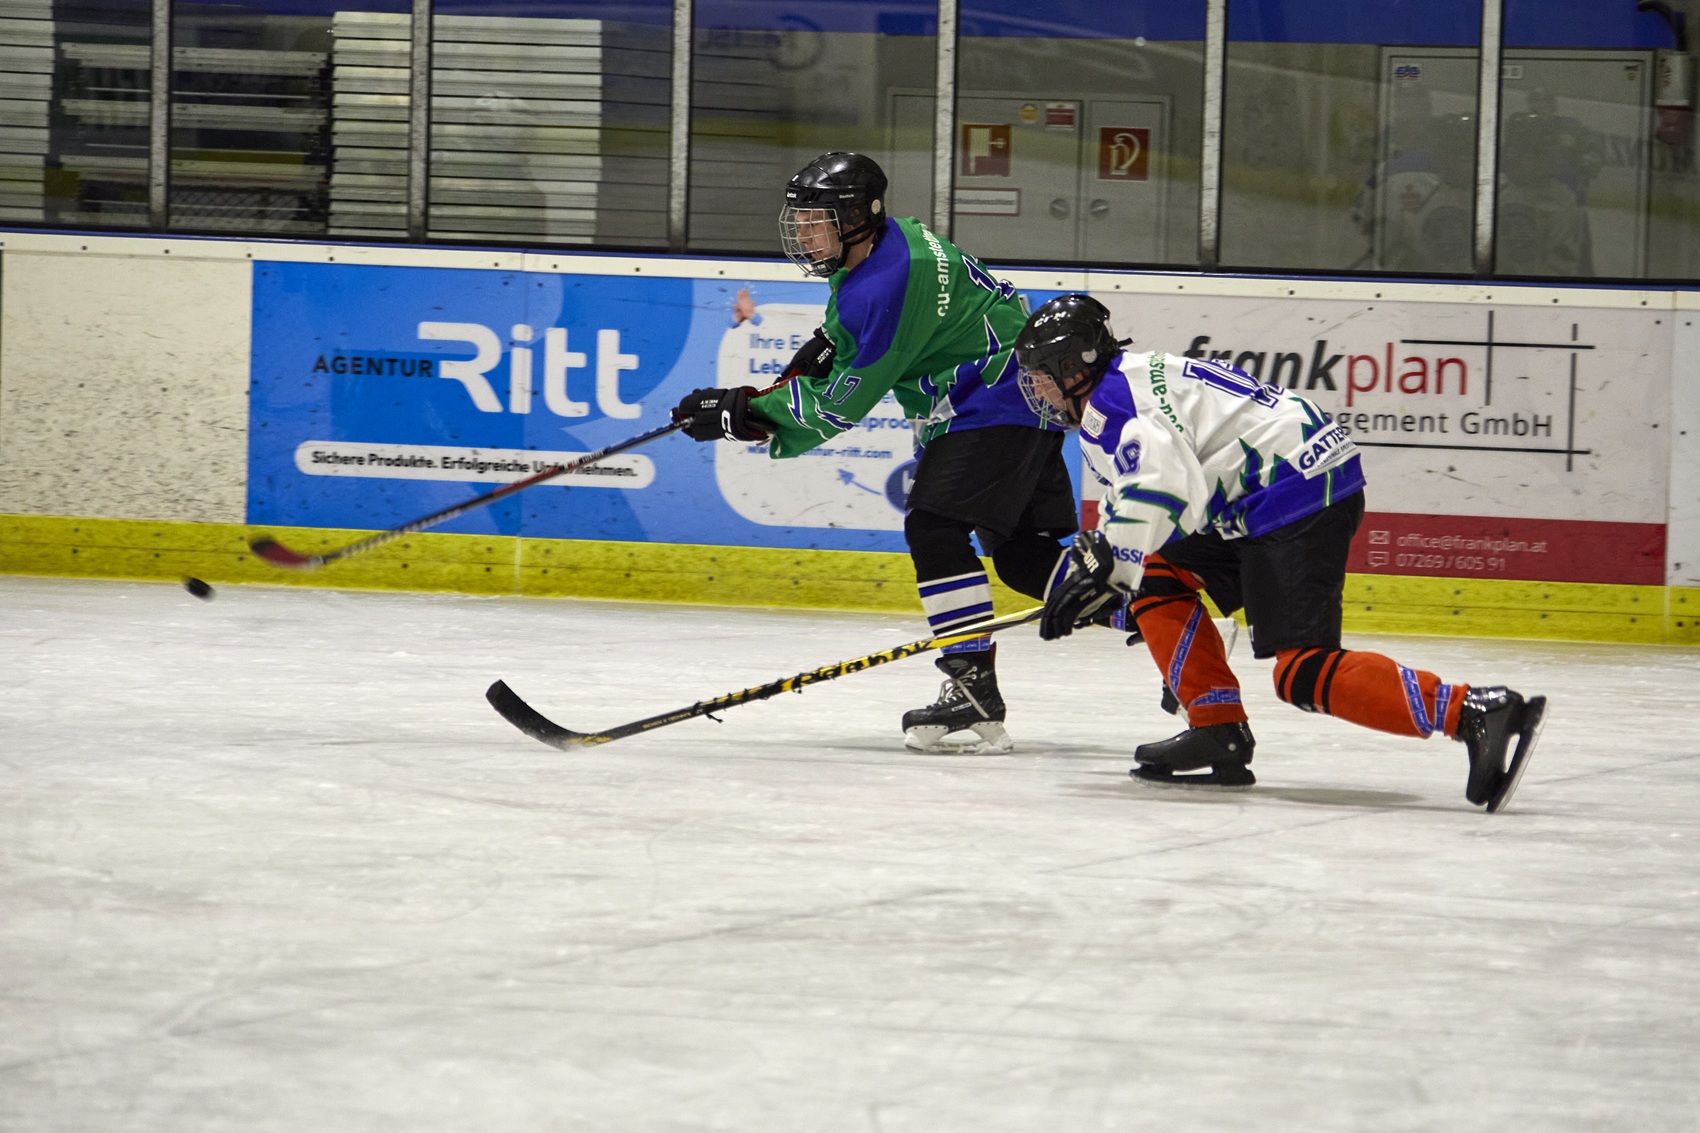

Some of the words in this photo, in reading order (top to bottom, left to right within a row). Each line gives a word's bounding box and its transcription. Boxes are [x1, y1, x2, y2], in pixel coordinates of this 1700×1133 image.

[749, 333, 785, 350] Ihre
[312, 354, 433, 378] AGENTUR
[417, 321, 642, 419] Ritt
[821, 372, 862, 406] 17
[1460, 412, 1552, 437] GmbH
[311, 450, 366, 466] Sichere
[367, 453, 438, 469] Produkte.
[440, 456, 530, 475] Erfolgreiche
[1396, 533, 1548, 554] office@frankplan.at
[1454, 556, 1486, 571] 605
[1487, 557, 1506, 571] 91
